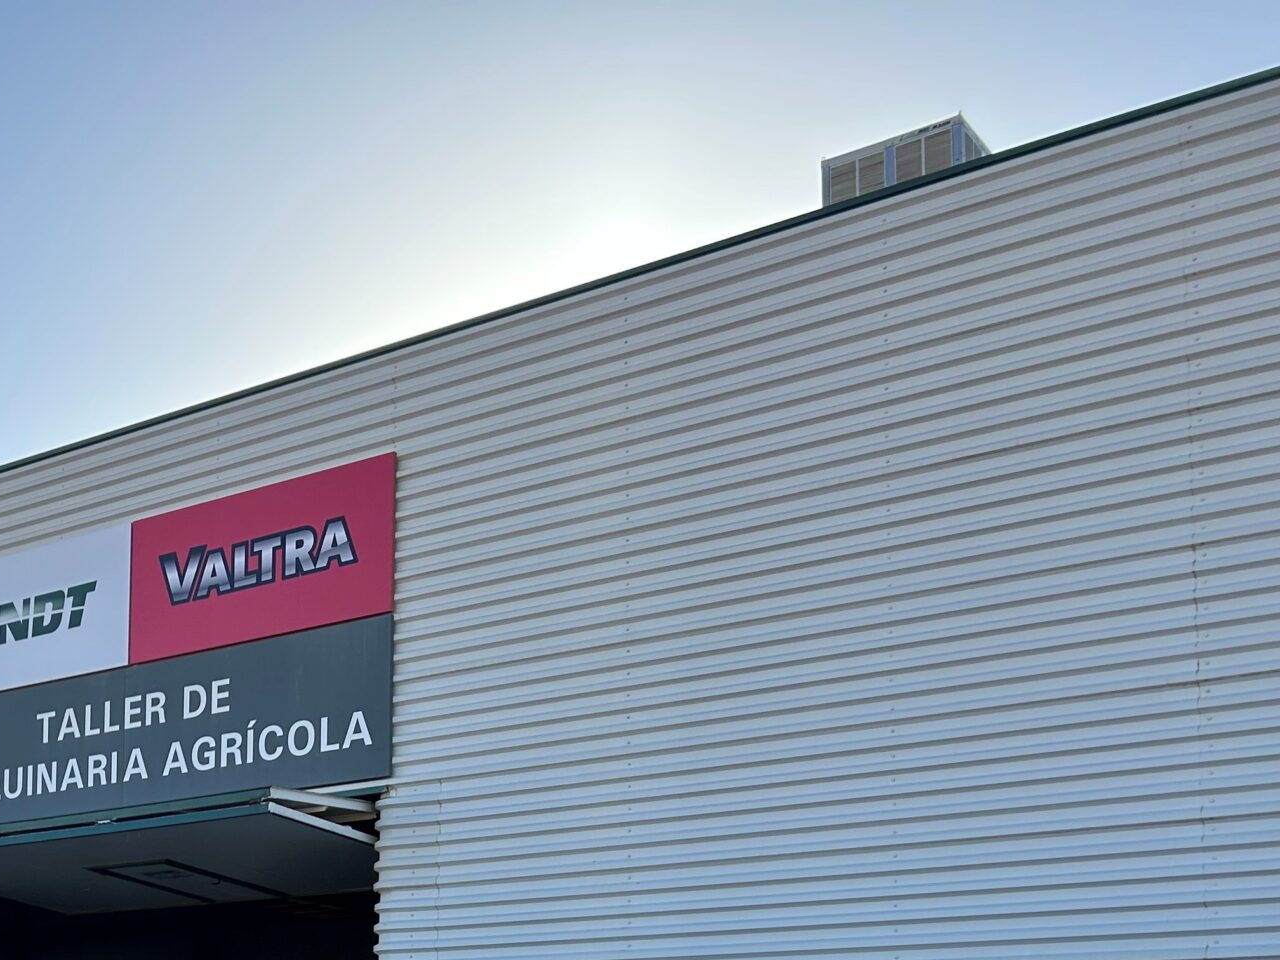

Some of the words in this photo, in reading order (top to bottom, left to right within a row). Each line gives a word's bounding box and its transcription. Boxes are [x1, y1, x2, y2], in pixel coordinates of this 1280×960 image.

[158, 515, 359, 606] VALTRA
[36, 692, 167, 744] TALLER
[182, 678, 231, 720] DE
[162, 710, 373, 777] AGRÍCOLA
